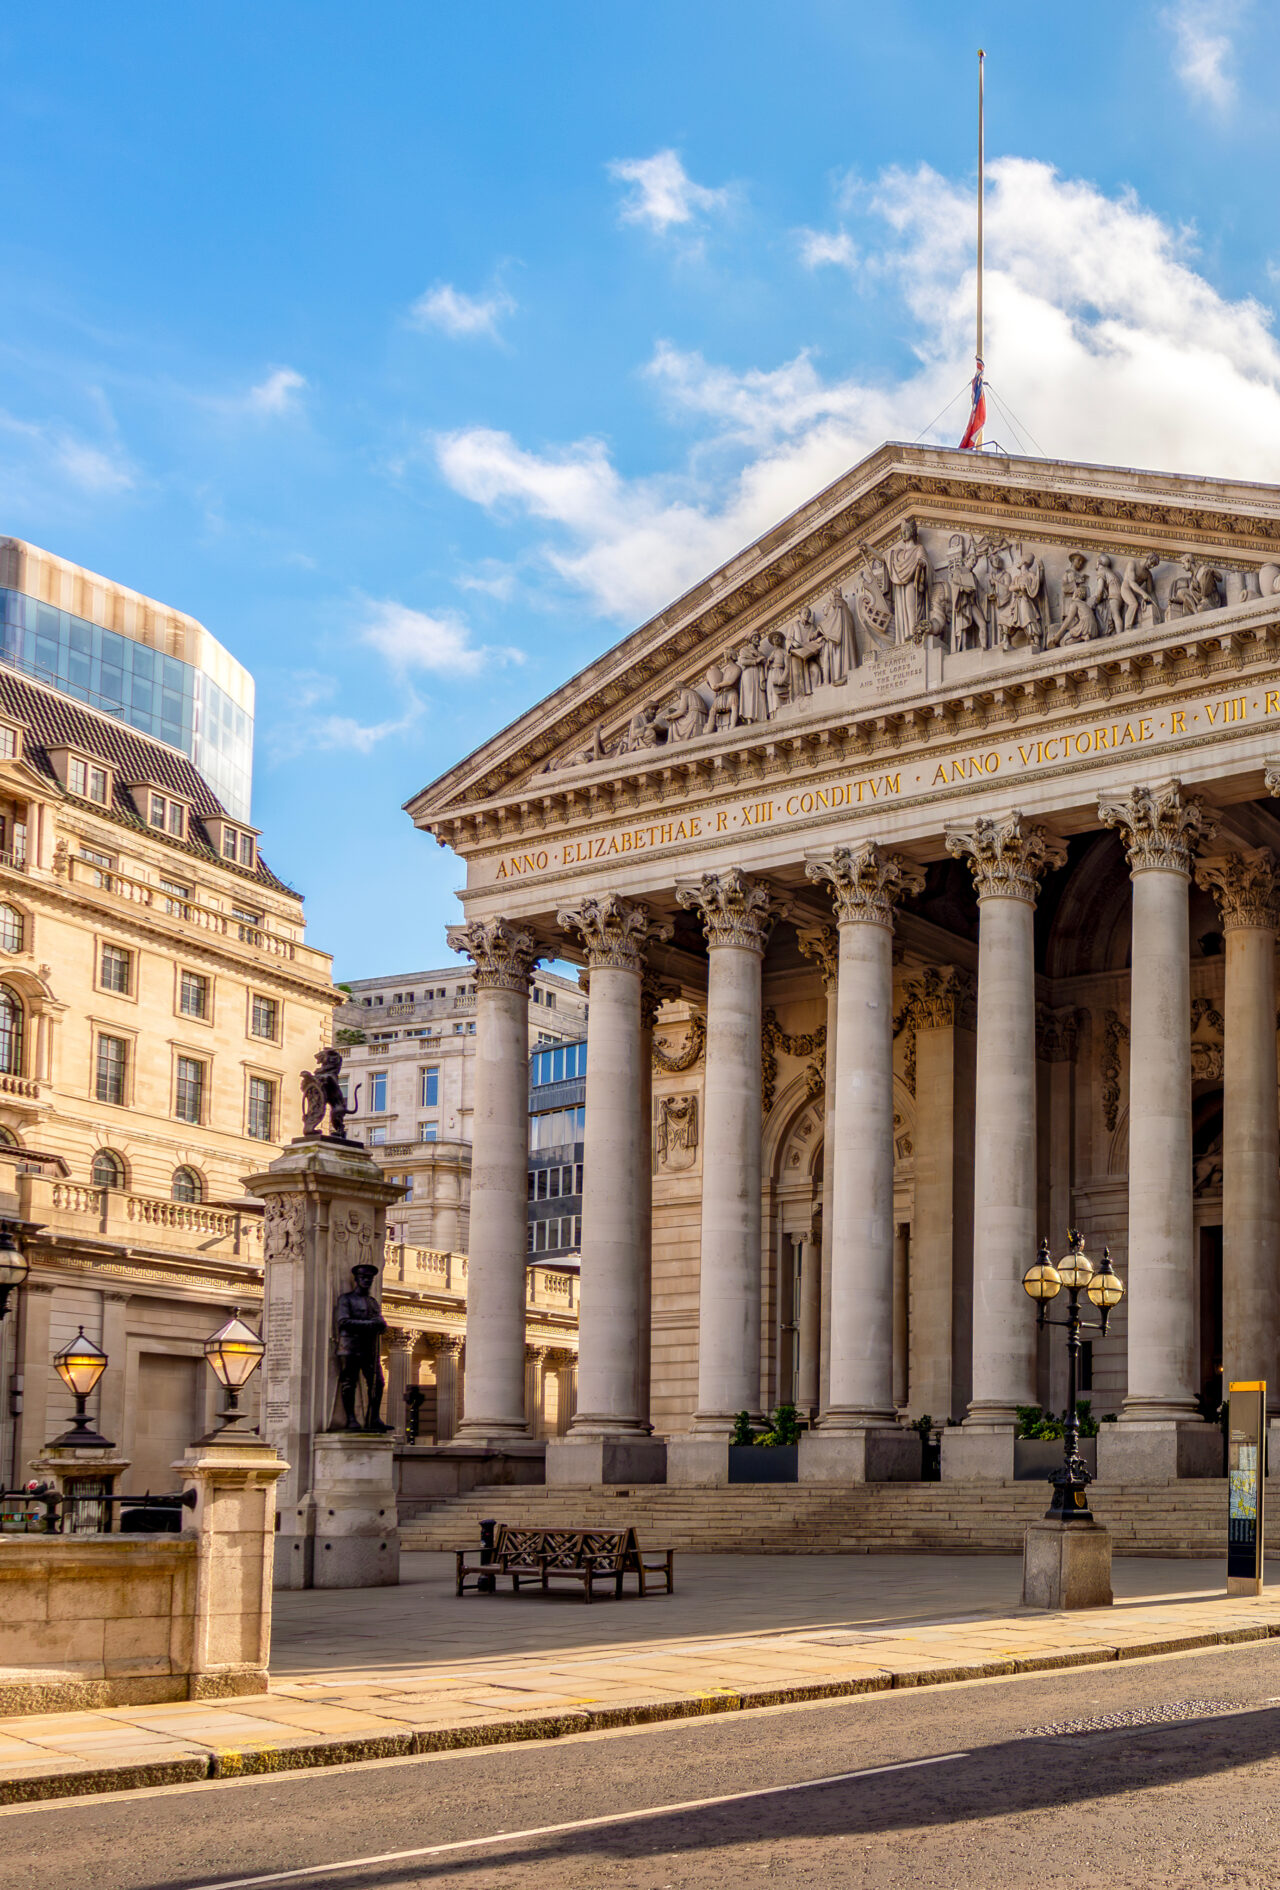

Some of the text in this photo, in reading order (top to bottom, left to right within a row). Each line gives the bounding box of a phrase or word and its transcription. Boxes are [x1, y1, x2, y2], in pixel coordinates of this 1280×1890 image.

[495, 850, 549, 880] ANNO
[562, 816, 703, 866] ELIZABETHAE
[716, 811, 729, 832] R
[740, 801, 775, 827] XIII
[786, 773, 902, 817] CONDITVM
[931, 752, 1001, 786] ANNO
[1018, 717, 1154, 766] VICTORIAE
[1170, 710, 1187, 735] R
[1204, 696, 1247, 726] VIII
